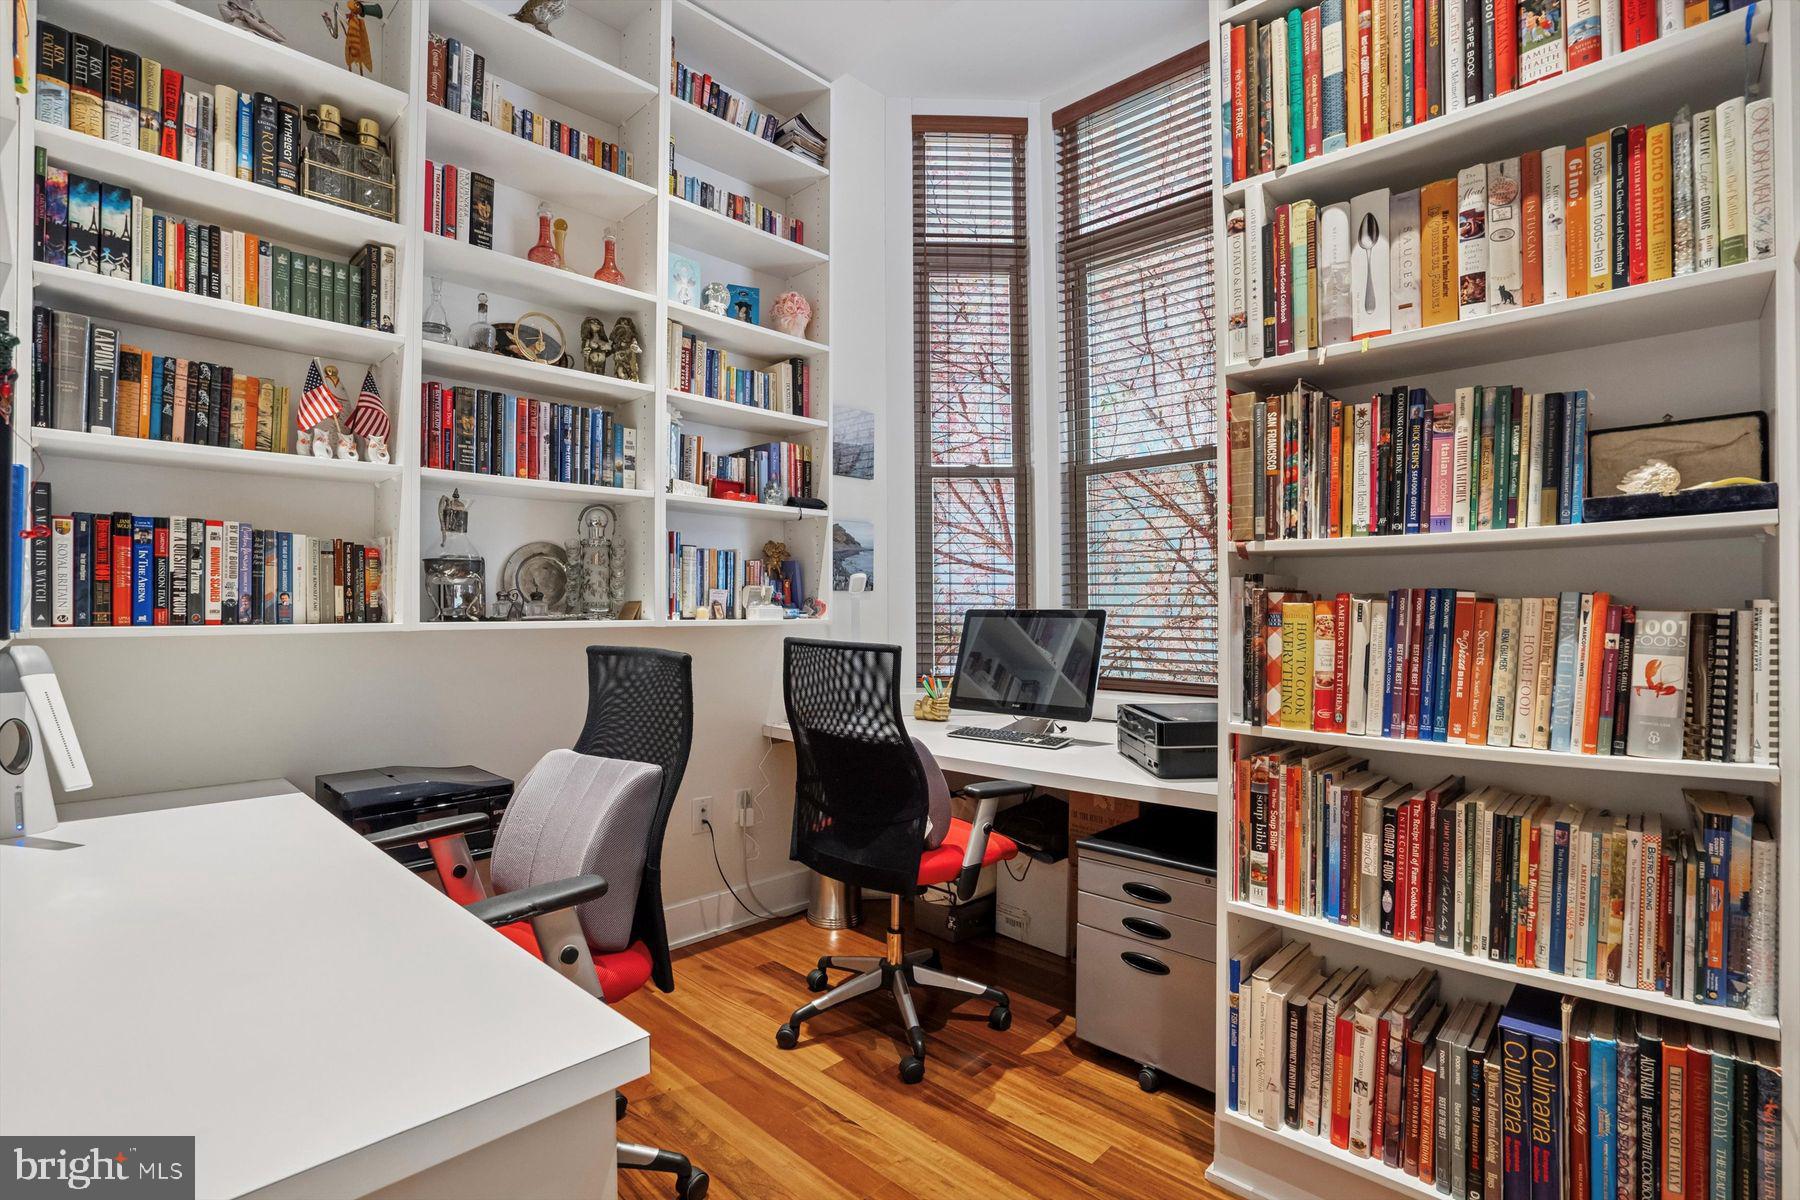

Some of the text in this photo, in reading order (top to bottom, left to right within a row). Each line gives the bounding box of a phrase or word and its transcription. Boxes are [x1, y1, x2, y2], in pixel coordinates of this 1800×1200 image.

[1430, 8, 1439, 48] RAMSAY'S
[42, 33, 53, 69] FOLLETT
[54, 44, 64, 64] KEN
[75, 43, 88, 84] FOLLETT
[90, 57, 102, 79] KEN
[1379, 44, 1387, 74] BIKERS
[1467, 27, 1475, 78] PIPE BOOK
[110, 55, 122, 94] FOLLETT
[124, 68, 135, 88] KEN
[1236, 84, 1244, 101] food
[166, 83, 176, 117] LEE CHILD
[1380, 77, 1388, 122] COOKBOOK
[283, 114, 293, 162] MYTHOLOGY
[1699, 116, 1711, 160] PACIFIC
[1752, 107, 1770, 140] ONE
[261, 131, 274, 177] ROME
[1568, 158, 1583, 208] Gino's
[1651, 132, 1665, 235] MOLTO BATALI
[1752, 175, 1771, 216] MEALS
[1527, 200, 1537, 265] IN TUSCANY
[1700, 195, 1711, 230] COOKING
[1251, 209, 1259, 276] GORDON RAMSAY
[1403, 225, 1413, 290] SAUCES
[211, 273, 219, 293] ZEALOT
[1233, 235, 1242, 313] POTATO & RICE
[1279, 214, 1288, 323] Ainsley Harriott's Feel-Good Cookbook
[1615, 262, 1624, 276] Italy
[94, 328, 115, 373] CAPONE
[1267, 412, 1277, 426] SAN
[1395, 393, 1404, 475] COOKING ON THE BONE
[1266, 430, 1277, 470] FRANCISCO
[1356, 419, 1370, 515] Super Abundant Health
[1456, 437, 1467, 504] AMERICAN KITCHEN
[1409, 425, 1421, 521] RICK STEIN'S SEAFOOD ODYSSEY
[1439, 443, 1450, 513] italian cooking
[230, 525, 238, 533] BY
[36, 550, 46, 566] HIS
[57, 543, 68, 608] ROYAL BRITAIN
[137, 550, 149, 602] IN THE ARENA
[210, 547, 220, 602] RUNNING SCARED
[35, 570, 46, 602] WATCH
[157, 558, 167, 607] MISSION ITALY
[172, 592, 186, 616] PROOF
[1476, 630, 1489, 666] Secrets
[1501, 628, 1509, 644] IRENA
[1635, 635, 1687, 648] FOODS
[1637, 620, 1686, 636] 1001
[1282, 622, 1294, 714] EVERYTHING
[1296, 622, 1307, 716] HOW TO COOK
[1336, 604, 1346, 711] AMERICA'S TEST KITCHEN
[1457, 638, 1469, 671] Pizza
[1519, 635, 1535, 717] HOME FOOD
[1555, 599, 1577, 725] FRENCH LEAVE
[1496, 696, 1505, 721] FAVORITES
[1254, 795, 1267, 850] soup bible
[1270, 810, 1278, 829] Soup
[1270, 831, 1278, 850] Bible
[1412, 819, 1421, 842] Recipe
[1383, 824, 1395, 883] COMFORT FOODS
[1398, 812, 1407, 882] INTERCOURSES
[1411, 859, 1418, 867] of
[1412, 843, 1420, 859] Hall
[1442, 819, 1452, 872] JIMMY DOHERTY
[1411, 868, 1420, 885] Fame
[1526, 863, 1538, 932] The Ultimate Pizza
[1646, 847, 1656, 911] BISTRO COOKING
[1410, 887, 1418, 920] Cookbook
[1578, 902, 1586, 927] BISTRO
[1504, 1041, 1526, 1133] Culinaria
[1532, 1049, 1556, 1143] Culinaria
[1640, 1055, 1656, 1159] AUSTRALIA THE BEAUTIFUL
[1713, 1064, 1729, 1141] ITALY TODAY
[1421, 1076, 1433, 1164] ITALIAN SOUP COOKBOOK
[1488, 1081, 1499, 1164] Years Australian Cooking
[1574, 1109, 1587, 1135] Italy
[1670, 1072, 1681, 1188] THE TASTE OF ITALY
